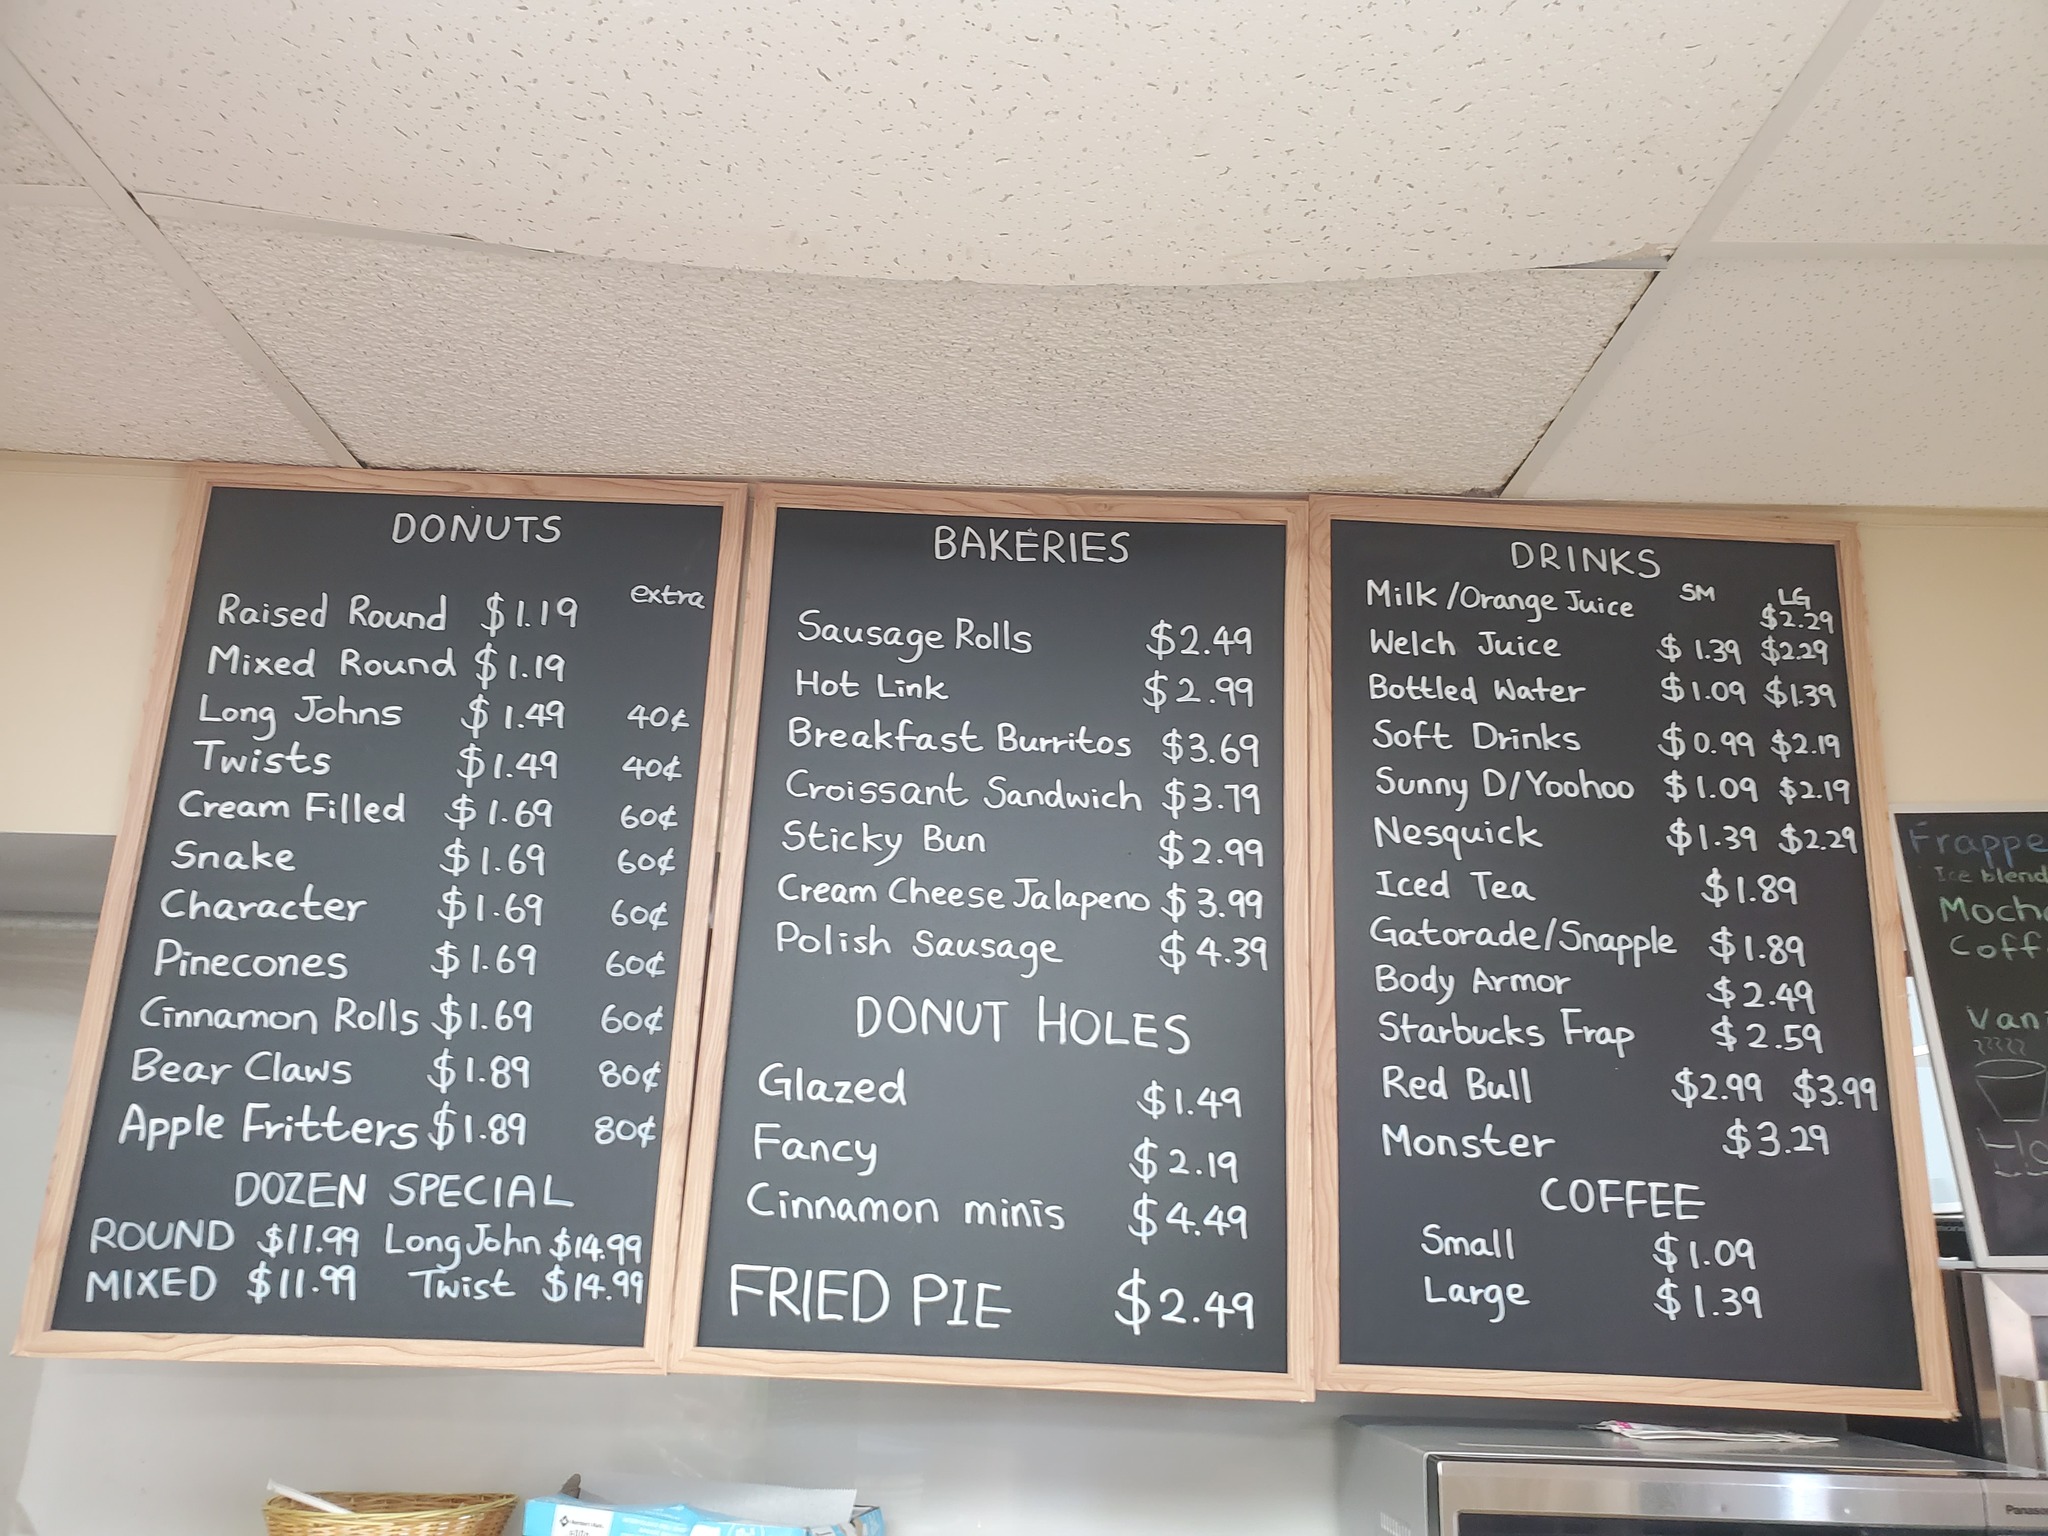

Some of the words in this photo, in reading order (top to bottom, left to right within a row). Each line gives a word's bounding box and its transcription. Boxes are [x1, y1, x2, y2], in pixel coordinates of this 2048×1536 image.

[391, 512, 562, 544] DONUTS
[934, 525, 1131, 564] BAKERIES
[1510, 541, 1661, 579] DRINKS
[218, 591, 328, 628] Raised
[348, 594, 447, 631] Round
[480, 591, 578, 638] $1.19
[630, 584, 706, 610] extra
[1563, 589, 1635, 618] Juice
[1759, 602, 1834, 634] $2.29
[1678, 582, 1716, 602] SM
[1777, 586, 1812, 611] LG
[797, 609, 945, 664] Sausage
[955, 617, 1033, 654] Rolls
[1145, 618, 1252, 661] $2.49
[1370, 628, 1457, 657] Welch
[1477, 630, 1562, 658] Juice
[1760, 634, 1829, 667] $2.29
[207, 644, 316, 678] Mixed
[340, 647, 457, 677] Round
[474, 641, 566, 691] $1.19
[796, 668, 860, 698] Hot
[877, 673, 949, 700] Link
[1142, 669, 1254, 714] $2.99
[1368, 673, 1479, 705] Bottled
[1493, 676, 1587, 703] Water
[1660, 671, 1747, 705] $1.09
[1762, 674, 1837, 709] $1.39
[198, 693, 277, 742] Long
[294, 695, 404, 726] Johns
[460, 693, 566, 739] $1.49
[626, 704, 690, 732] 40¢
[1372, 718, 1454, 750] Soft
[1472, 721, 1582, 751] Drinks
[1657, 721, 1756, 761] $0.99
[1770, 728, 1841, 763] $2.19
[192, 739, 332, 776] Twists
[456, 742, 558, 789] $1.49
[621, 755, 683, 782] 40¢
[788, 716, 984, 753] Breakfast
[997, 722, 1132, 757] Burritos
[1161, 727, 1260, 768] $3.69
[178, 789, 290, 820] Cream
[305, 791, 406, 824] Filled
[443, 793, 553, 831] $1.69
[620, 804, 679, 831] 60¢
[785, 768, 969, 807] Croissant
[983, 775, 1143, 812] Sandwich
[1161, 777, 1261, 820] $3.79
[1375, 765, 1469, 812] Sunny
[1482, 768, 1635, 801] D/Yoohoo
[1663, 769, 1759, 804] $1.09
[1778, 776, 1851, 806] $2.19
[170, 840, 296, 872] Snake
[439, 836, 546, 877] $1.69
[617, 847, 676, 876] 60¢
[781, 819, 903, 867] Sticky
[923, 824, 986, 853] Bun
[1158, 829, 1264, 870] $2.99
[1373, 815, 1544, 861] Nesquick
[1665, 816, 1758, 857] $1.39
[1778, 822, 1858, 855] $2.29
[1375, 869, 1451, 899] Iced
[1469, 870, 1537, 902] Tea
[1700, 867, 1798, 909] $1.89
[1934, 865, 1973, 882] Ice
[160, 883, 368, 922] Character
[436, 884, 544, 930] $1.69
[610, 899, 669, 931] 60¢
[777, 873, 878, 905] Cream
[888, 876, 1006, 910] Cheese
[1012, 878, 1151, 921] Jalapeno
[1160, 882, 1263, 924] $3.99
[153, 938, 349, 980] Pinecones
[430, 940, 537, 980] $1.69
[605, 950, 666, 978] 60¢
[776, 921, 892, 956] Polish
[912, 929, 1064, 979] Sausage
[1158, 929, 1268, 975] $4.39
[1369, 915, 1678, 968] Gatorade/Snapple
[1708, 925, 1807, 968] $1.89
[1950, 931, 2048, 961] Coff
[1374, 963, 1455, 1006] Body
[1472, 967, 1572, 995] Armor
[1705, 975, 1816, 1015] $2.49
[139, 995, 318, 1035] Cinnamon
[334, 996, 420, 1036] Rolls
[430, 992, 533, 1041] $1.69
[600, 1003, 664, 1036] 60¢
[856, 995, 1010, 1043] DONUT
[1038, 995, 1191, 1055] HOLES
[1378, 1010, 1546, 1047] Starbucks
[1559, 1007, 1636, 1059] Frap
[1710, 1014, 1824, 1054] $2.59
[131, 1047, 233, 1085] Bear
[244, 1050, 352, 1085] Claws
[426, 1047, 530, 1094] $1.89
[598, 1059, 662, 1093] 80¢
[758, 1062, 907, 1106] Glazed
[1136, 1079, 1242, 1120] $1.49
[1382, 1065, 1449, 1101] Red
[1465, 1067, 1533, 1104] Bull
[1670, 1066, 1764, 1109] $2.99
[1792, 1067, 1879, 1112] $3.99
[118, 1102, 225, 1152] Apple
[242, 1102, 420, 1150] Fritters
[427, 1100, 527, 1151] $1.89
[594, 1115, 656, 1149] 80¢
[1381, 1123, 1557, 1159] Monster
[1721, 1117, 1830, 1160] $3.29
[754, 1122, 877, 1177] Fancy
[1128, 1136, 1239, 1185] $2.19
[234, 1171, 367, 1210] DOZEN
[388, 1171, 575, 1209] SPECIAL
[746, 1181, 940, 1224] Cinnamon
[964, 1198, 1066, 1231] minis
[1127, 1191, 1248, 1246] $4.49
[1540, 1177, 1706, 1221] COFFEE
[89, 1217, 235, 1254] ROUND
[256, 1222, 360, 1259] $11.99
[385, 1222, 462, 1271] Long
[465, 1222, 542, 1257] John
[548, 1226, 643, 1266] $14.99
[1420, 1223, 1515, 1260] Small
[1652, 1230, 1757, 1274] $1.09
[85, 1265, 218, 1303] MIXED
[246, 1260, 357, 1305] $11.99
[407, 1265, 517, 1301] Twist
[541, 1263, 642, 1304] $14.99
[730, 1263, 890, 1324] FRIED
[913, 1273, 1013, 1329] PIE
[1114, 1267, 1255, 1336] $2.49
[1424, 1275, 1531, 1324] Large
[1653, 1277, 1763, 1321] $1.39
